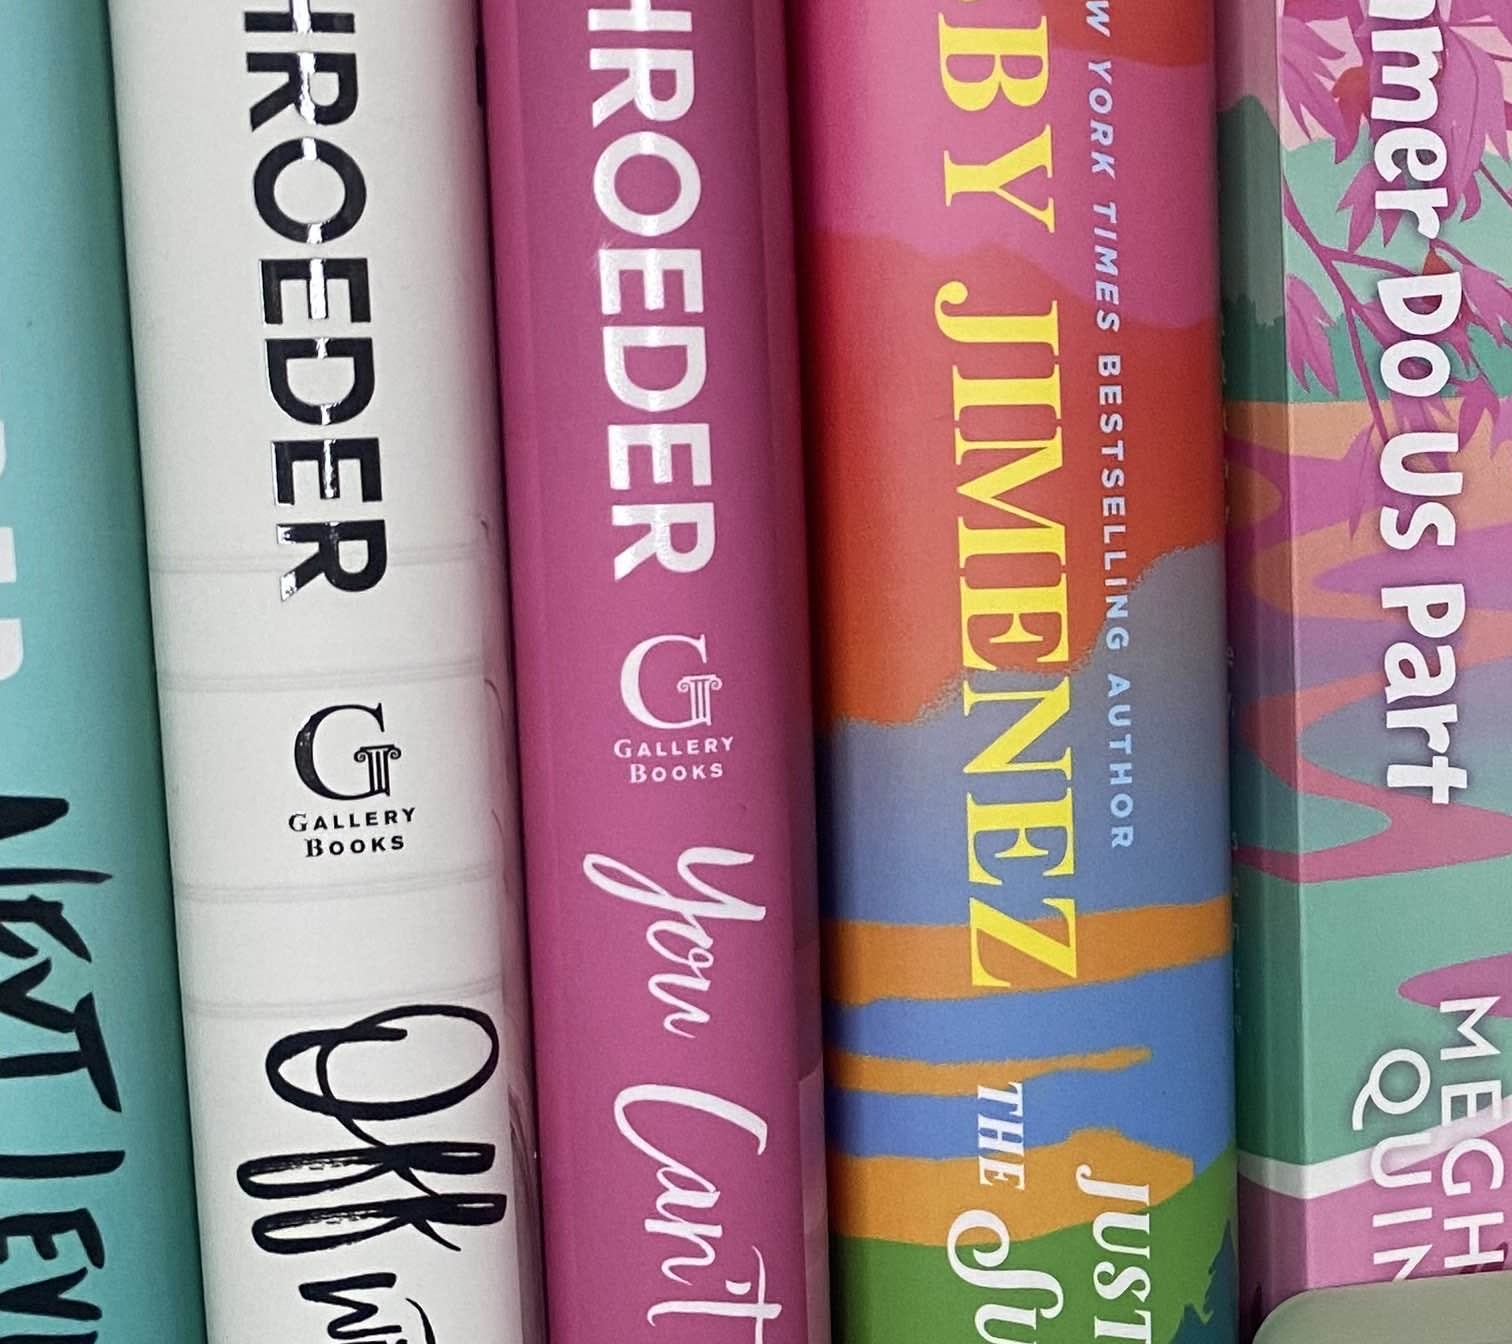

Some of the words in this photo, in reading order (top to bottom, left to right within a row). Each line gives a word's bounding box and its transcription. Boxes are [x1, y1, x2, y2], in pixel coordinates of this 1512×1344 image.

[1088, 61, 1118, 176] YORK
[1090, 200, 1122, 332] TIMES
[1097, 353, 1130, 652] BESTSELLING
[933, 279, 1079, 990] JIMENEZ
[614, 736, 735, 759] GALLERY
[629, 761, 725, 784] BOOKS
[1107, 676, 1135, 850] AUTHOR
[289, 807, 416, 834] GALLERY
[304, 834, 405, 858] BOOKS
[583, 846, 767, 1039] You
[236, 1003, 507, 1255] Off
[977, 1081, 1026, 1190] THE
